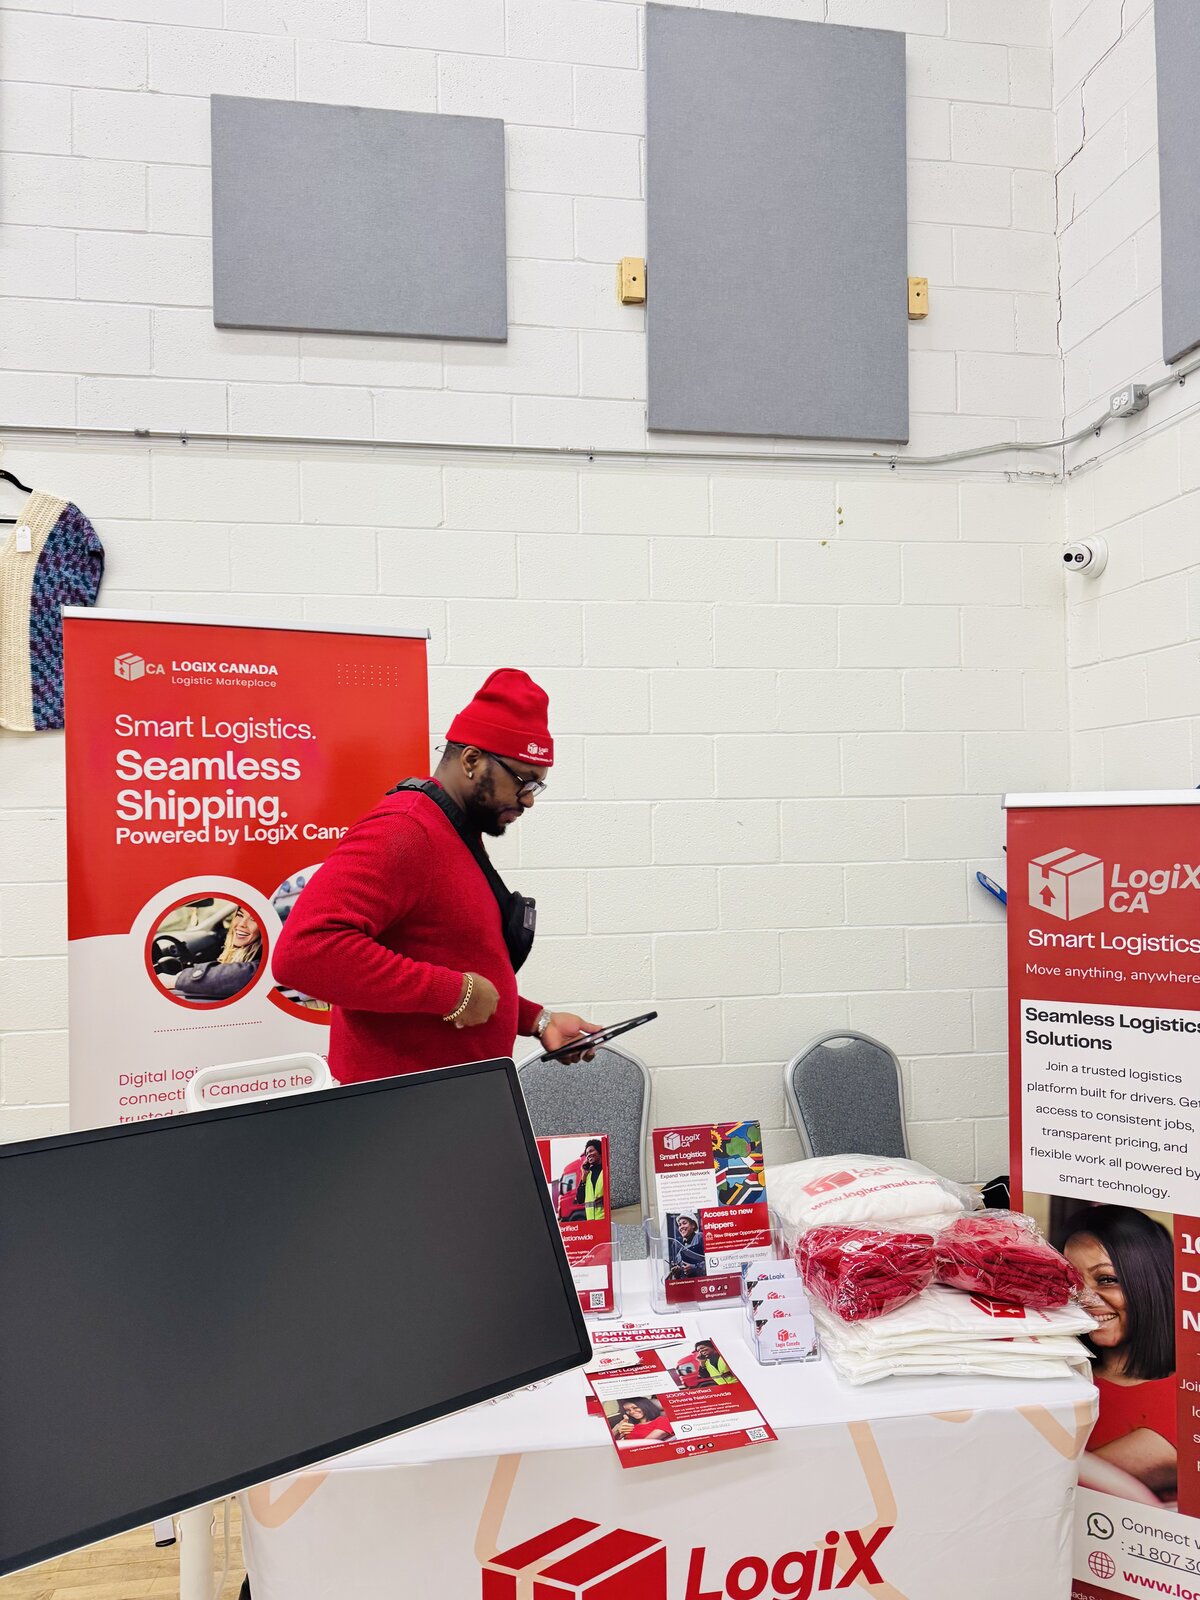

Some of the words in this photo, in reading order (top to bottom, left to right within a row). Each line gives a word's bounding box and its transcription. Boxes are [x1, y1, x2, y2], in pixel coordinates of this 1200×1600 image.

[146, 663, 166, 675] CA
[172, 660, 217, 673] LOGIX
[218, 662, 279, 676] CANADA
[172, 676, 213, 687] Logistic
[216, 677, 277, 689] Markeplace
[114, 714, 195, 738] Smart
[202, 716, 317, 744] Logistics.
[115, 749, 301, 781] Seamless
[116, 788, 289, 828] Shipping.
[116, 826, 210, 846] Powered
[214, 825, 240, 846] by
[244, 824, 299, 846] LogiX
[302, 823, 350, 841] Cana
[1110, 863, 1200, 895] LogiX
[1108, 891, 1150, 914] CA
[1028, 928, 1096, 949] Smart
[1100, 931, 1200, 956] Logistics
[1026, 963, 1061, 977] Move
[1064, 965, 1127, 983] anything,
[1130, 968, 1200, 986] anywhere
[1025, 1007, 1115, 1027] Seamless
[1026, 1030, 1112, 1050] Solutions
[119, 1069, 167, 1088] Digital
[172, 1066, 199, 1083] logi
[1046, 1061, 1069, 1072] Join
[1071, 1065, 1079, 1073] a
[1081, 1065, 1126, 1078] trusted
[1129, 1068, 1183, 1083] logistics
[119, 1087, 205, 1107] connecti
[209, 1080, 269, 1097] Canada
[272, 1077, 287, 1089] to
[290, 1074, 313, 1087] the
[1027, 1081, 1078, 1095] platform
[1080, 1086, 1107, 1098] built
[1110, 1090, 1127, 1100] for
[1130, 1092, 1176, 1106] drivers.
[1036, 1105, 1078, 1117] access
[1081, 1110, 1093, 1119] to
[1096, 1112, 1162, 1128] consistent
[1164, 1119, 1195, 1133] jobs,
[1042, 1127, 1112, 1144] transparent
[1115, 1137, 1161, 1152] pricing,
[1164, 1143, 1188, 1154] and
[680, 1151, 707, 1160] Logistics
[1030, 1146, 1072, 1161] flexible
[1074, 1154, 1106, 1166] work
[1109, 1157, 1122, 1168] all
[1126, 1160, 1182, 1176] powered
[1186, 1167, 1200, 1181] by
[1058, 1173, 1095, 1186] smart
[1097, 1179, 1171, 1199] technology.
[704, 1210, 728, 1218] Access
[561, 1225, 579, 1233] erified
[693, 1392, 732, 1400] Nationwide
[1121, 1517, 1190, 1547] Connect
[684, 1526, 894, 1600] LogiX
[1149, 1547, 1181, 1566] 807
